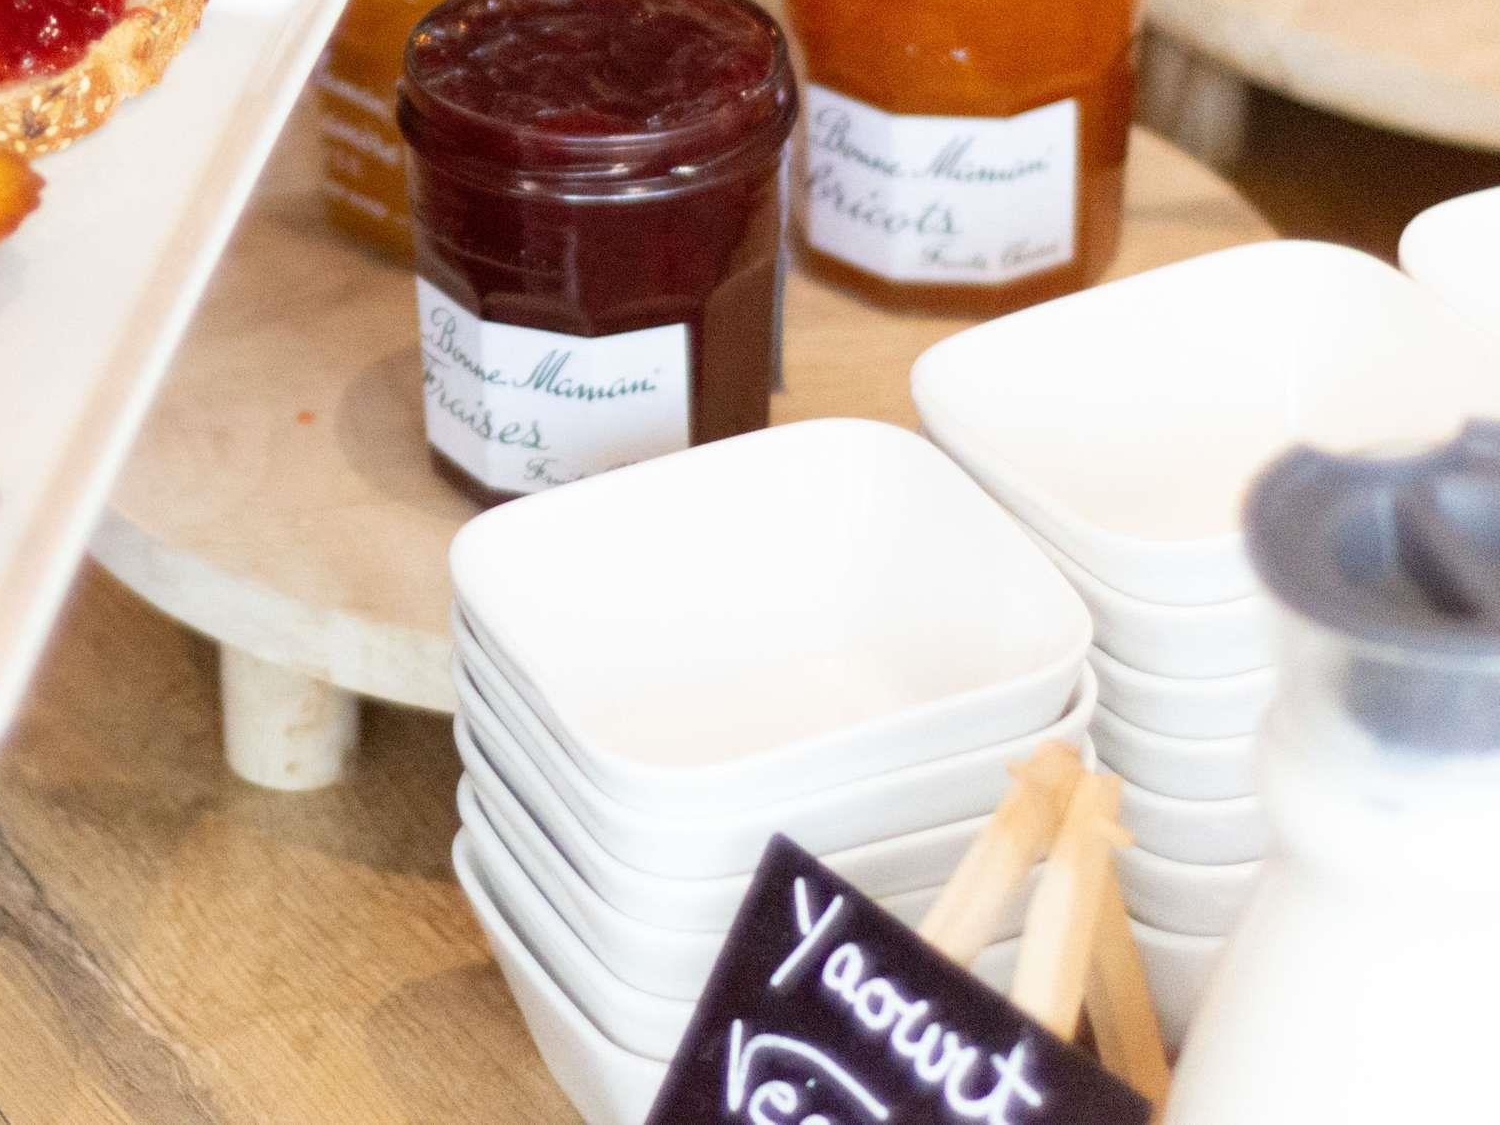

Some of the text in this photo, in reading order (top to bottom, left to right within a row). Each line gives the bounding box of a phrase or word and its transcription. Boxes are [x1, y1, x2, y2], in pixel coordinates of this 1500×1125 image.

[422, 307, 657, 401] Bonne Maman
[769, 875, 1045, 1125] Yaourt
